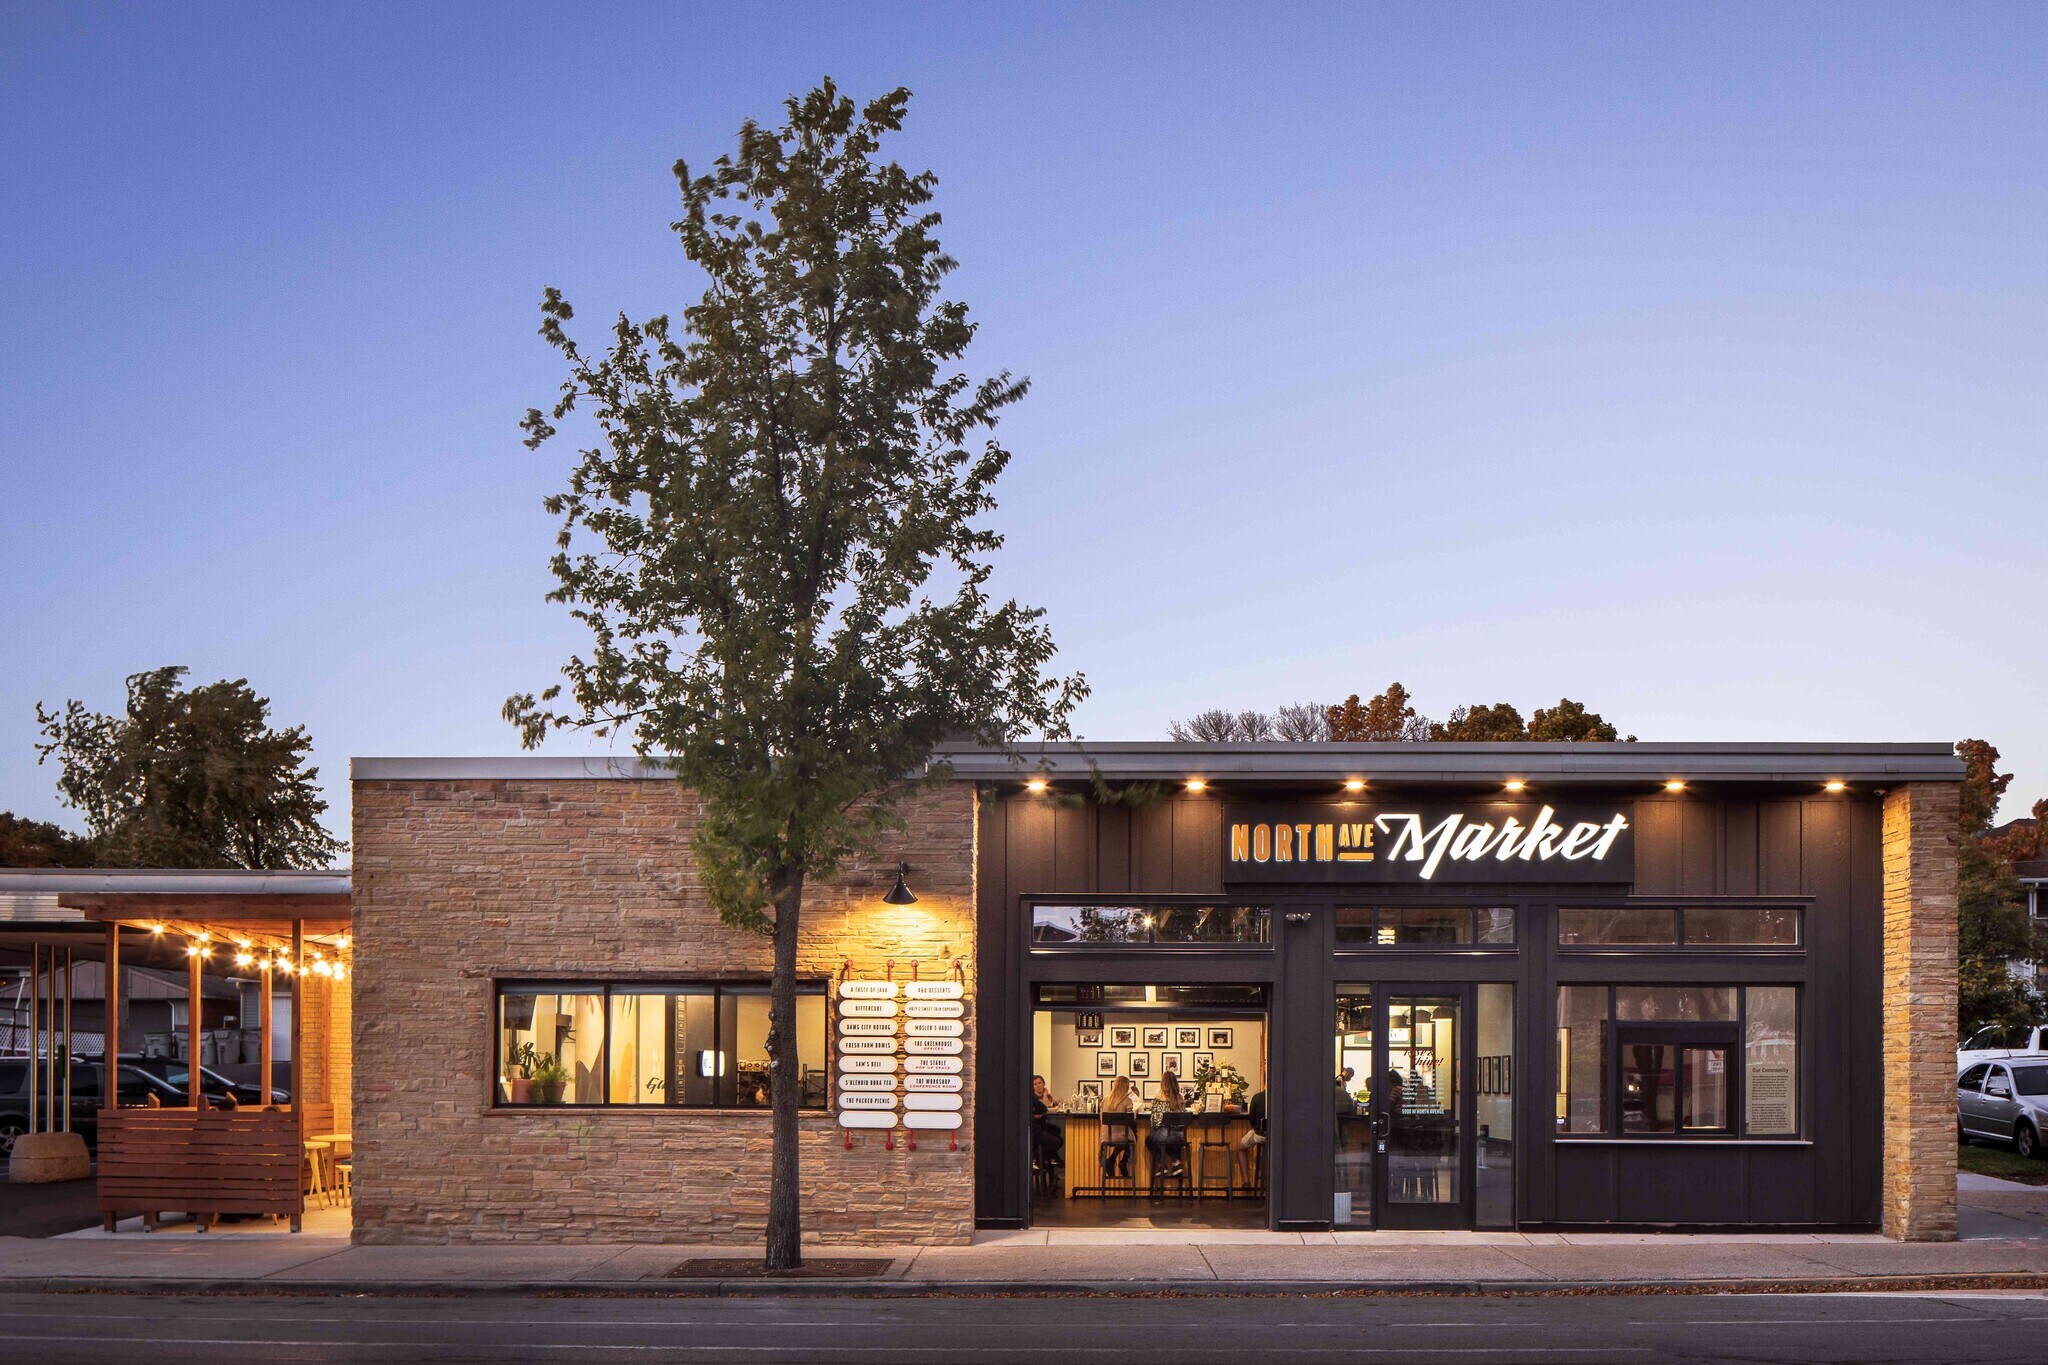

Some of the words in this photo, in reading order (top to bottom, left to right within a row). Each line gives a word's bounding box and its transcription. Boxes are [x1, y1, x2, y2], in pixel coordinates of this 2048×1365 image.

[1231, 823, 1334, 862] NORTH
[1338, 823, 1375, 848] AVE
[1374, 804, 1630, 880] Market
